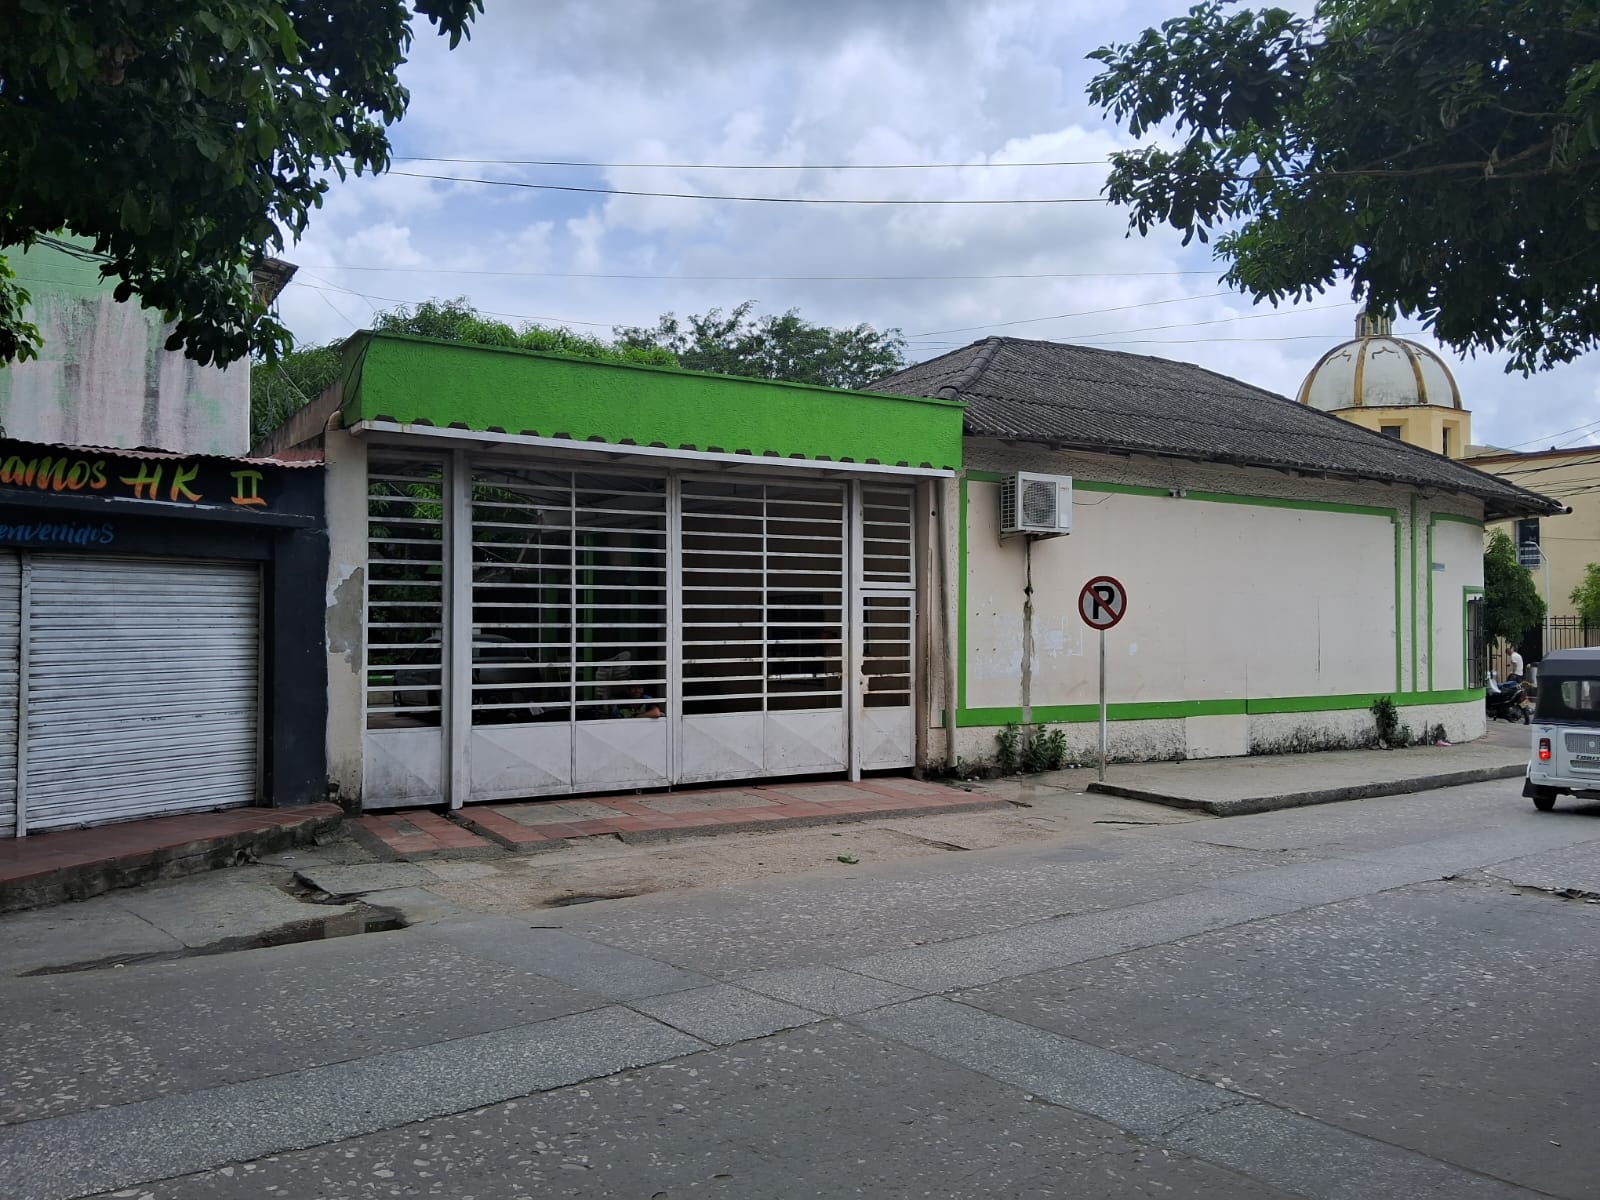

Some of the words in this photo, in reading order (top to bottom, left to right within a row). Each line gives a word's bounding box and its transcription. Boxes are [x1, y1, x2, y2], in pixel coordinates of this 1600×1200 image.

[0, 455, 107, 492] amos
[119, 461, 204, 502] HK
[1092, 585, 1115, 620] P
